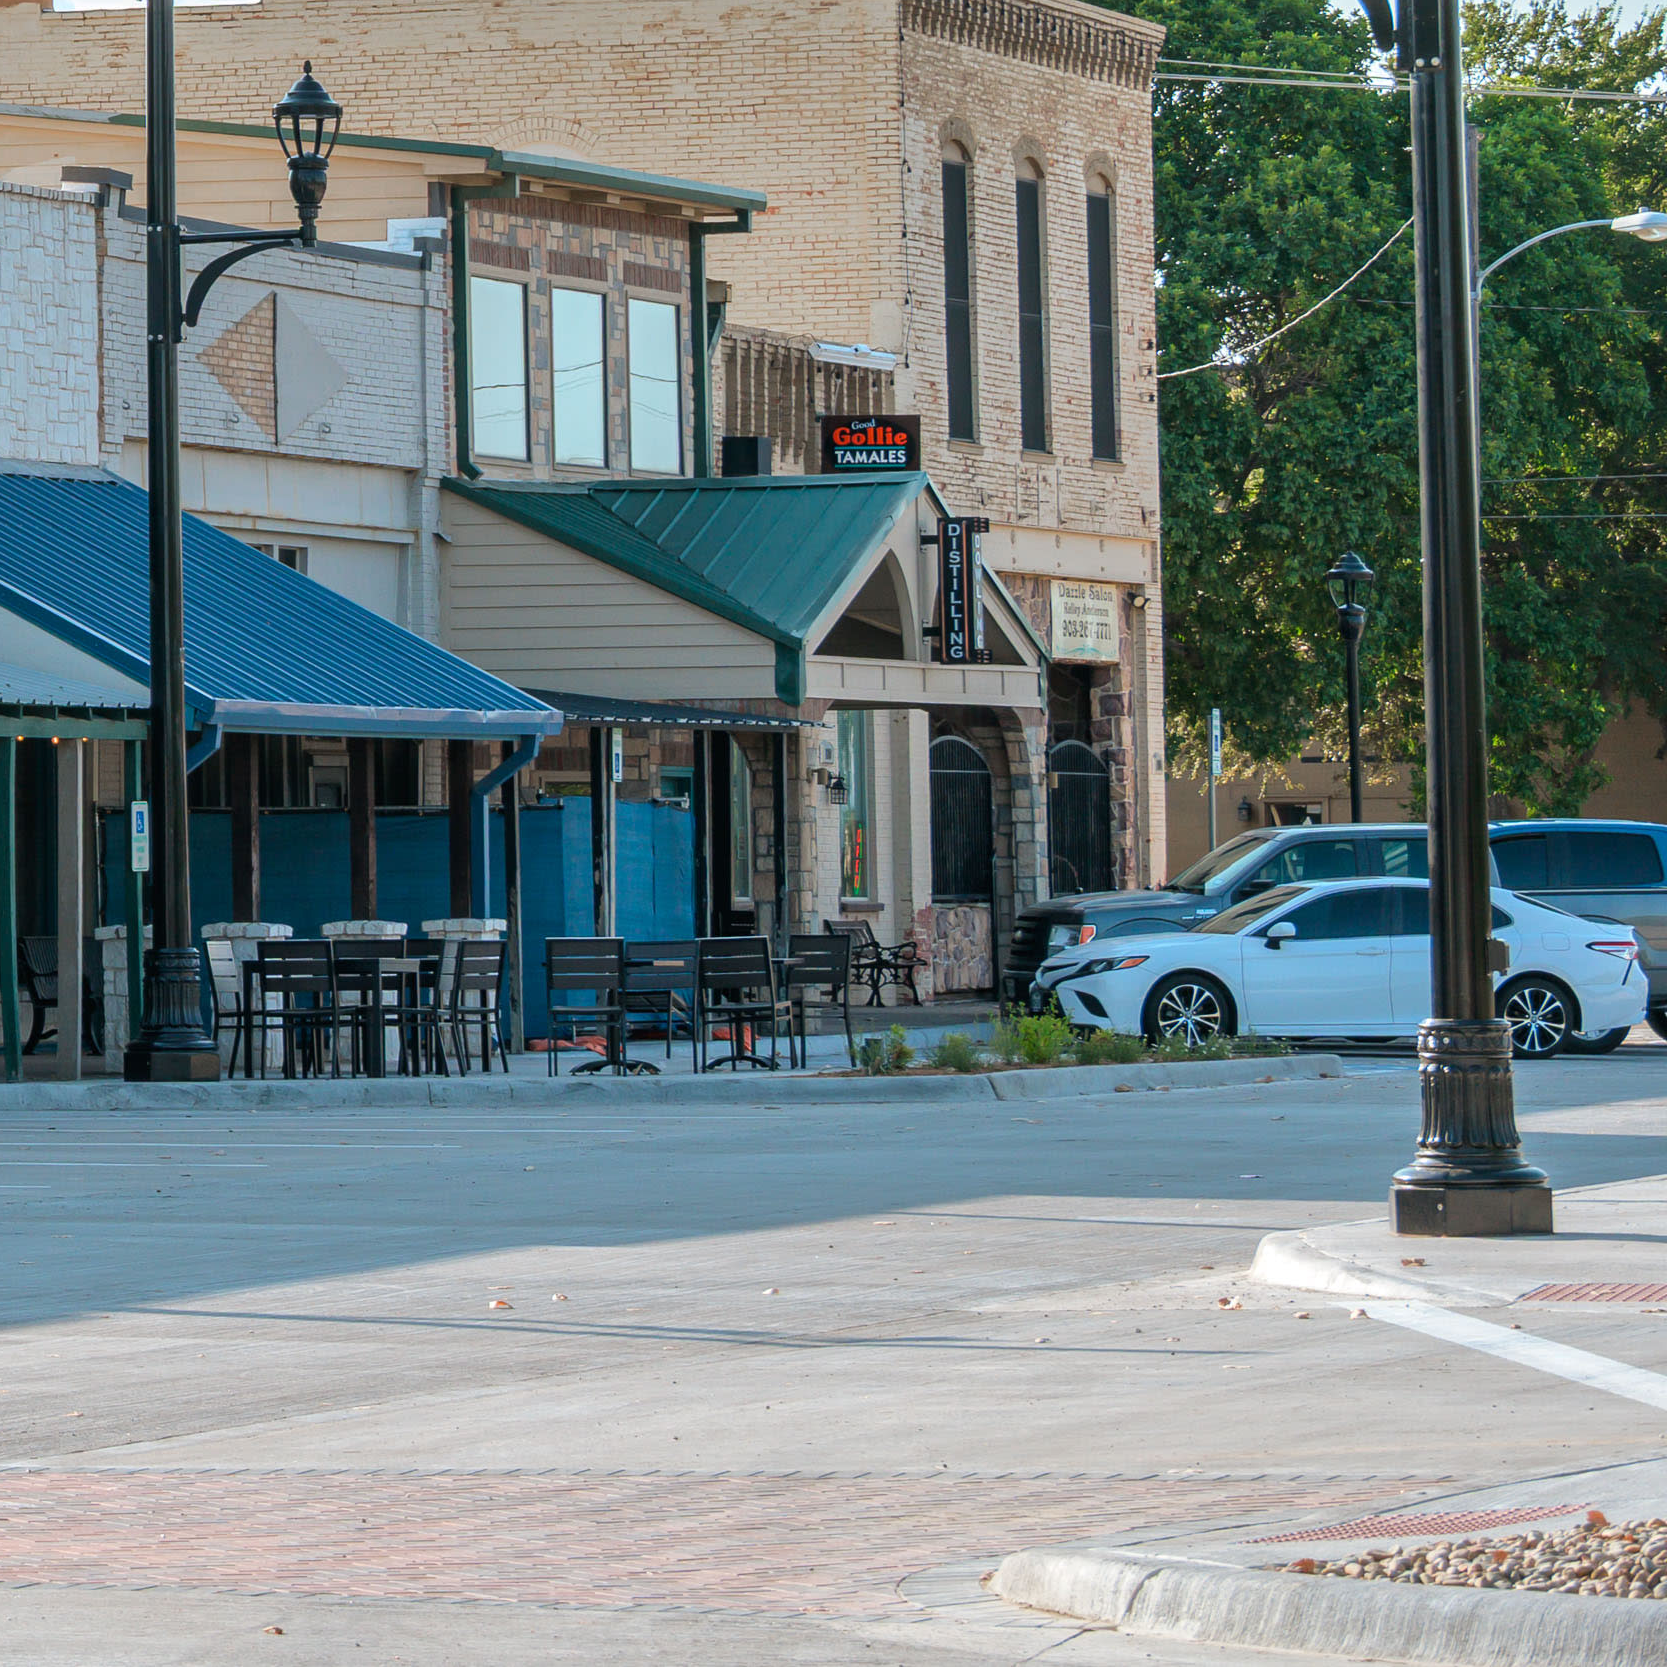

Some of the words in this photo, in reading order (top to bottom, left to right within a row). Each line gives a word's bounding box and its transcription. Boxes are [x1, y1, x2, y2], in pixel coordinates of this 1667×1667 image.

[851, 418, 876, 430] Good
[832, 426, 908, 446] Gollie
[834, 449, 907, 464] TAMALES
[947, 523, 964, 659] DISTILLING
[973, 534, 985, 649] DOWLING
[1058, 582, 1086, 599] Dazzle
[1088, 584, 1114, 602] Salon
